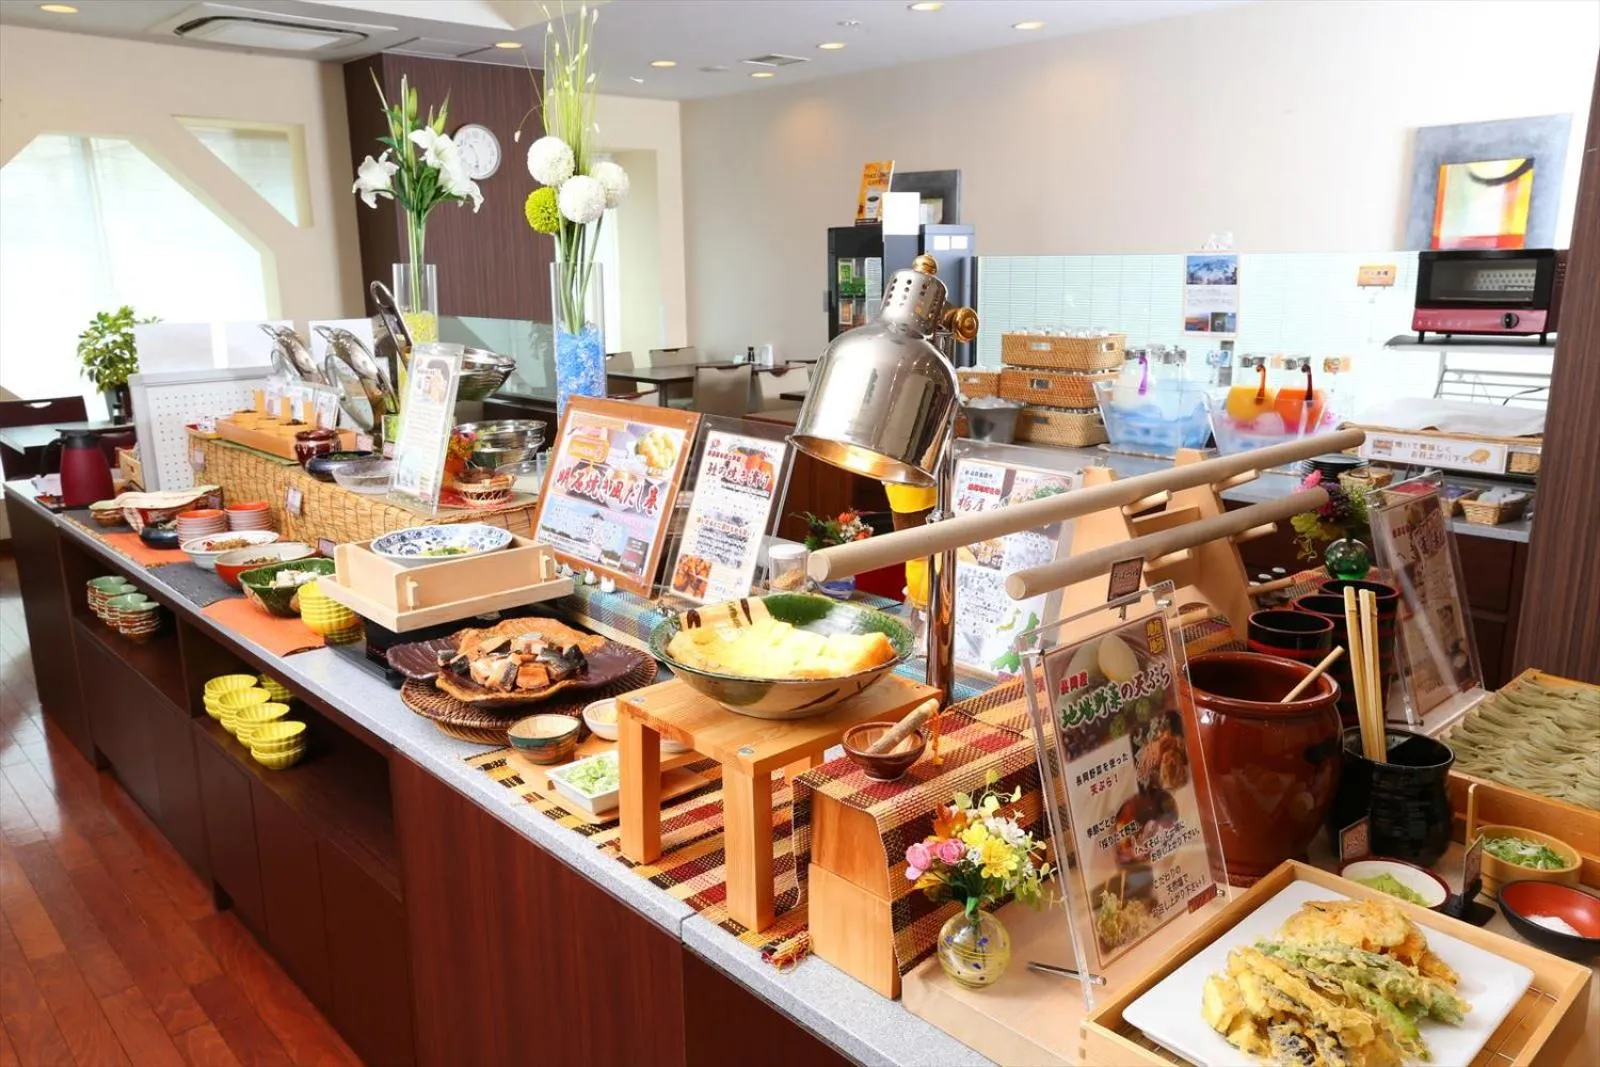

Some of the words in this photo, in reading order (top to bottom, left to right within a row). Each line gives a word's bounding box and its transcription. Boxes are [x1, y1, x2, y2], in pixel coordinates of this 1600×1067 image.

[1060, 662, 1171, 729] 地場野菜の天ぷら
